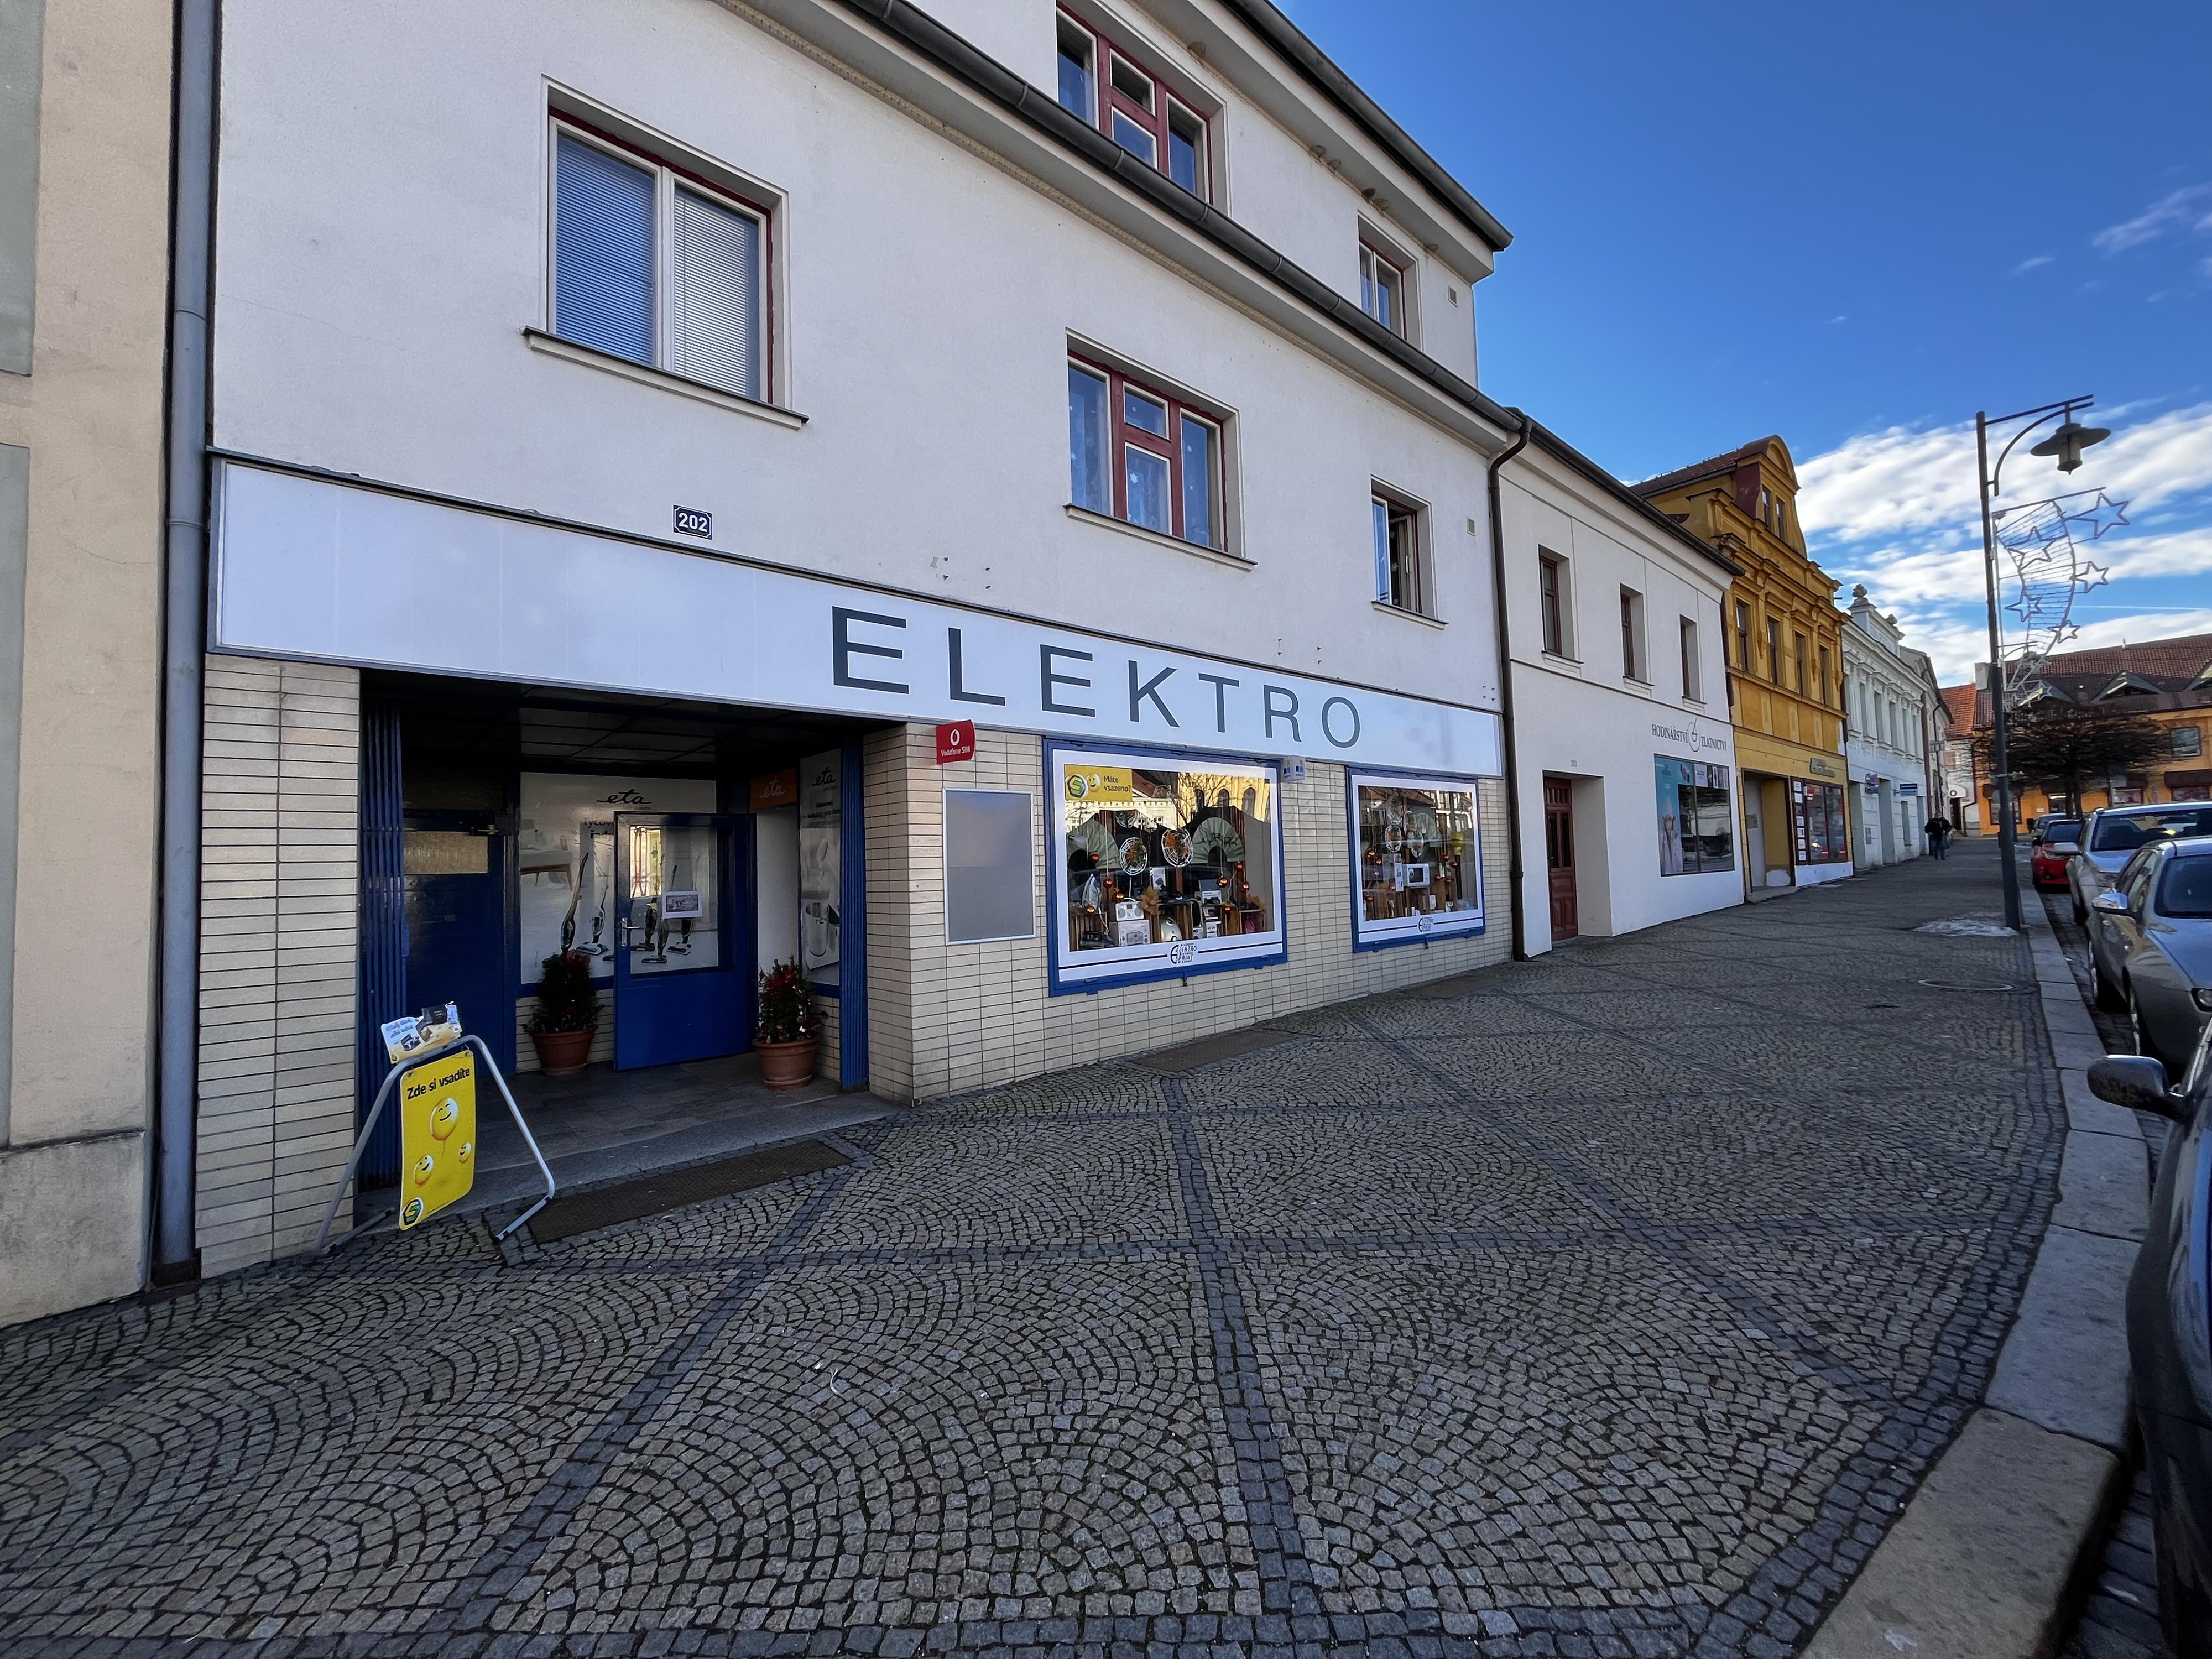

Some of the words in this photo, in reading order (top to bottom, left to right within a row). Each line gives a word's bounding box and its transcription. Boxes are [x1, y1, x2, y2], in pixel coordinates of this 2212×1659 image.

[679, 512, 708, 533] 202
[832, 606, 1360, 748] ELEKTRO
[941, 748, 961, 757] Vodafone
[811, 766, 837, 786] eta
[597, 789, 652, 804] eta
[759, 775, 786, 799] eta
[1176, 945, 1197, 953] ELEKTRO
[407, 1084, 426, 1100] Zde
[429, 1078, 436, 1091] si
[439, 1068, 470, 1087] vsadíte
